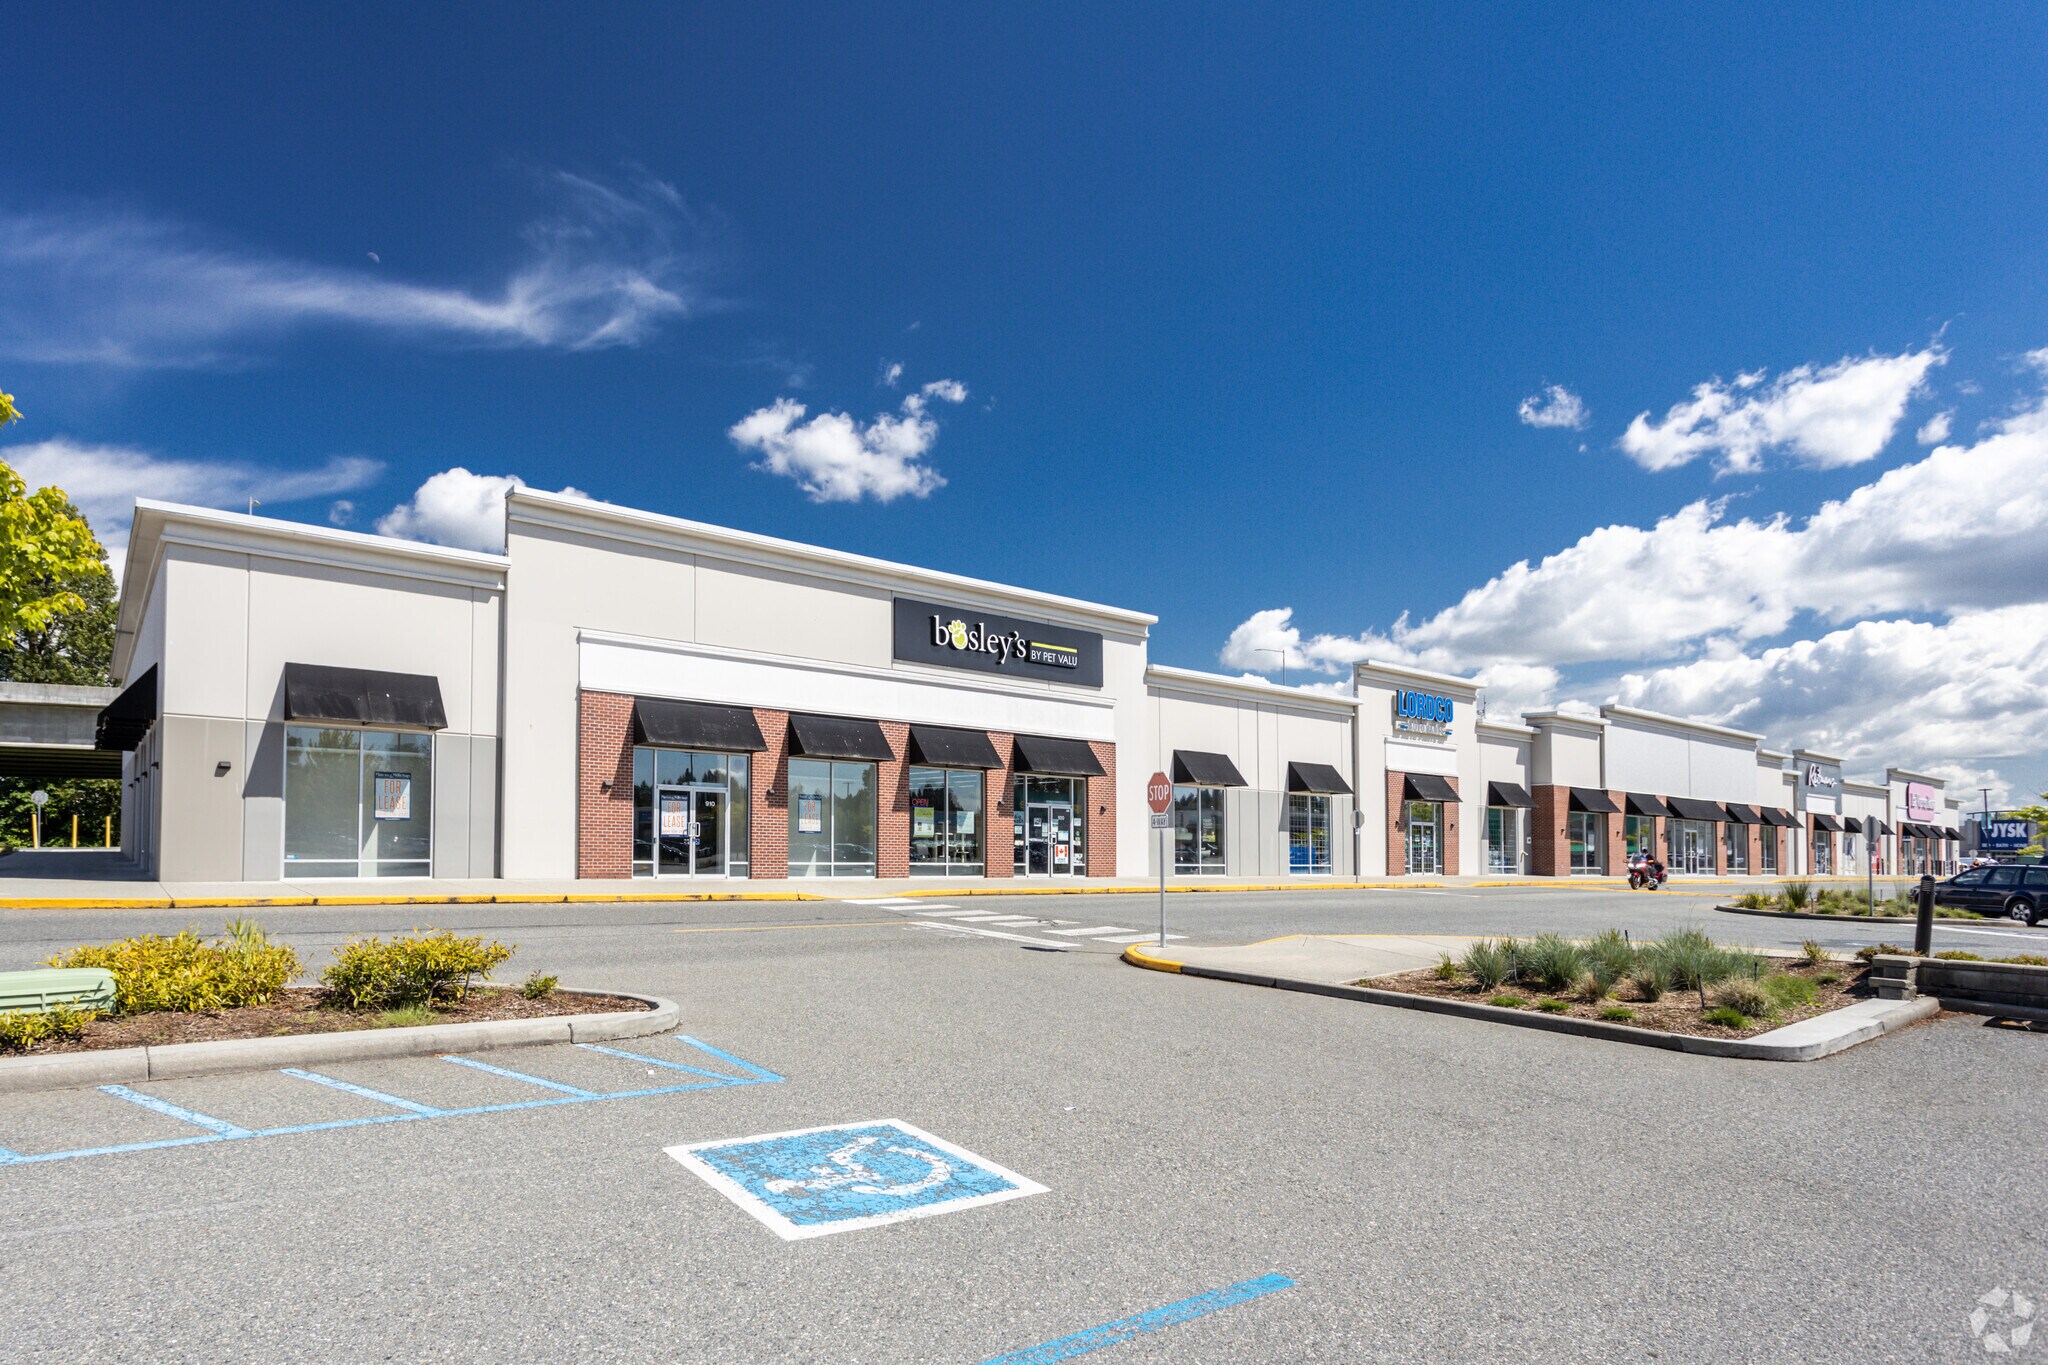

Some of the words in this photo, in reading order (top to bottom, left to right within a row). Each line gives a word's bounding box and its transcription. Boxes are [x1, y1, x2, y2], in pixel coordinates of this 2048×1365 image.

[934, 615, 1027, 664] bosley's
[1031, 650, 1041, 660] BY
[1043, 652, 1056, 663] PET
[1058, 655, 1078, 666] VALU
[1398, 689, 1454, 723] LORDCO
[384, 780, 401, 794] FOR
[1149, 784, 1170, 801] STOP
[378, 795, 406, 810] LEASE
[667, 801, 681, 814] FOR
[911, 798, 929, 806] OPEN
[663, 815, 685, 828] LEASE
[1991, 822, 2027, 838] JYSK
